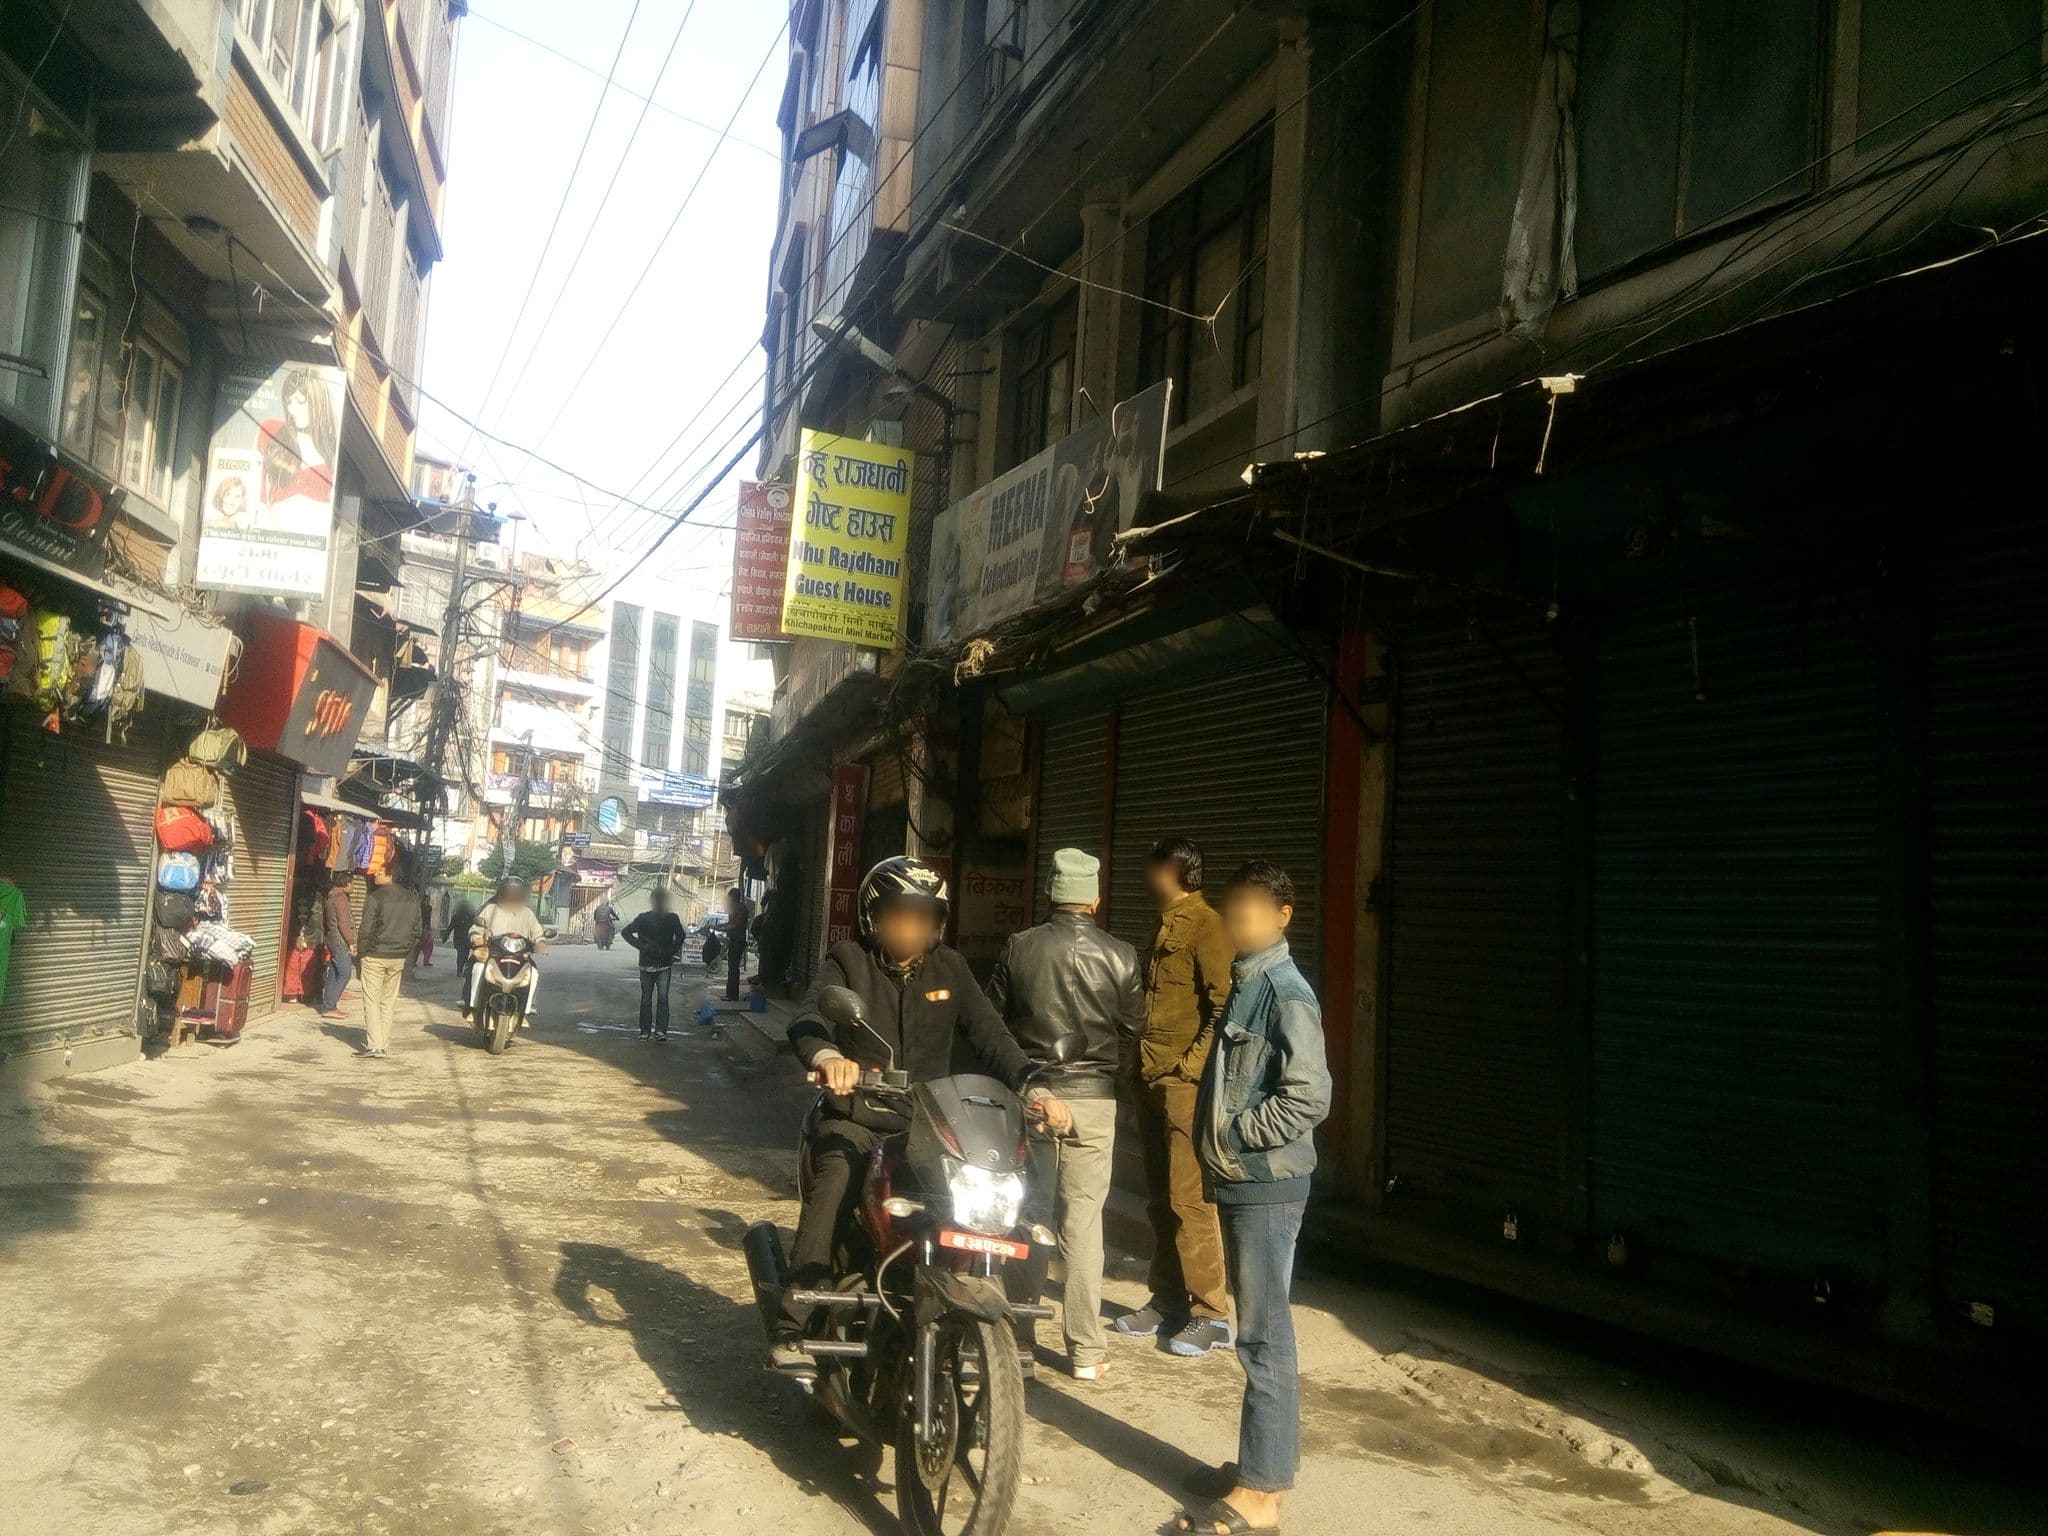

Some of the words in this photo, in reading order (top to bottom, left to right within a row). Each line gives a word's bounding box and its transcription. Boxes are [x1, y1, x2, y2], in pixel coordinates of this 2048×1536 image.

[833, 455, 909, 495] राजधानी
[806, 491, 843, 533] गेष्ट
[846, 507, 897, 544] हाउस
[792, 539, 825, 565] Nhu
[828, 545, 900, 577] Rajdhani
[795, 573, 840, 600] Guest
[843, 581, 892, 609] House
[785, 617, 844, 635] Khichapokhari
[846, 627, 863, 639] Mini
[864, 630, 894, 643] Market
[843, 613, 864, 627] मिनी
